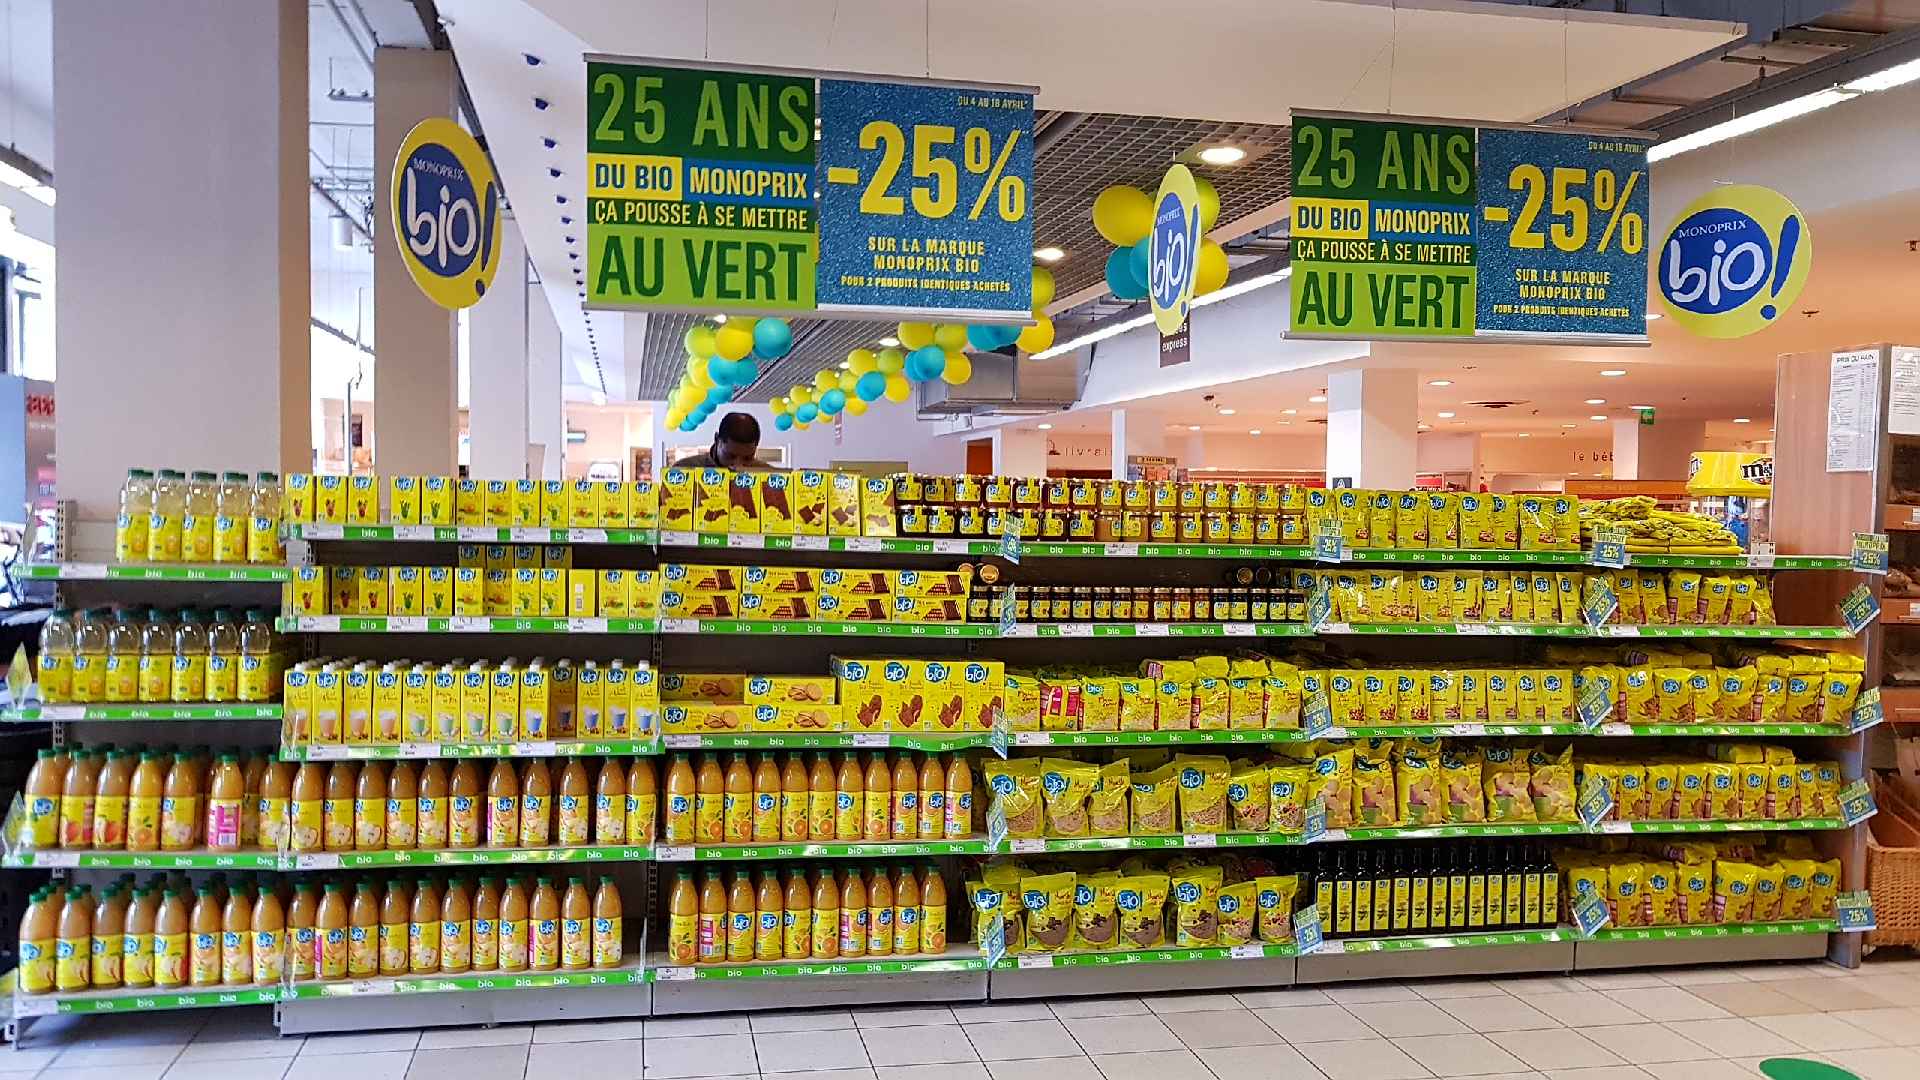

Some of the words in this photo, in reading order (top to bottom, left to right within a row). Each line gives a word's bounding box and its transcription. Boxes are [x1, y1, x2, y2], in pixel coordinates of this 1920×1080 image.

[970, 96, 976, 105] 4
[594, 73, 665, 144] 25
[693, 80, 809, 152] ANS
[1297, 126, 1356, 188] 25
[1377, 131, 1470, 194] ANS
[828, 120, 1025, 222] -25%
[596, 164, 625, 189] DU
[635, 166, 672, 191] BIO
[690, 166, 807, 199] MONOPRIX
[1484, 164, 1642, 254] -25%
[595, 200, 618, 224] ÇA
[625, 202, 691, 225] POUSSE
[698, 201, 708, 225] À
[715, 206, 734, 227] SE
[742, 207, 808, 230] METTRE
[1298, 206, 1322, 229] DU
[1330, 208, 1362, 231] BIO
[1376, 208, 1470, 235] MONOPRIX
[1678, 220, 1748, 238] MONOPRIX
[868, 236, 896, 252] SUR
[902, 238, 920, 252] LA
[926, 239, 984, 256] MARQUE
[1297, 240, 1316, 261] ÇA
[1322, 242, 1376, 260] POUSSE
[1380, 239, 1390, 260] À
[1395, 244, 1412, 261] SE
[1418, 244, 1471, 264] METTRE
[596, 236, 664, 297] AU
[683, 239, 807, 301] VERT
[874, 255, 948, 272] MONOPRIX
[956, 258, 980, 273] BIO
[1516, 268, 1538, 282] SUR
[1544, 270, 1556, 282] LA
[1562, 270, 1610, 286] MARQUE
[841, 276, 864, 286] POUR
[866, 278, 872, 286] 2
[875, 277, 918, 288] PRODUITS
[921, 278, 971, 291] IDENTIQUES
[1520, 285, 1581, 300] MONOPRIX
[1586, 288, 1606, 300] BIO
[1298, 272, 1352, 326] AU
[1368, 274, 1470, 328] VERT
[1162, 336, 1188, 352] express
[1065, 446, 1107, 456] livrai
[1592, 451, 1614, 462] béb
[362, 528, 378, 537] bio
[704, 537, 719, 545] bio
[776, 539, 791, 547] bio
[1861, 552, 1880, 566] -25%
[736, 624, 750, 632] bio
[772, 624, 786, 632] bio
[808, 624, 821, 632] bio
[843, 624, 856, 632] bio
[770, 738, 784, 746] bio
[1074, 734, 1087, 742] bio
[1106, 734, 1118, 742] bio
[596, 744, 610, 754] bio
[1134, 838, 1146, 846] bio
[950, 844, 963, 852] bio
[473, 854, 488, 862] bio
[624, 850, 639, 858] bio
[707, 850, 720, 858] bio
[1190, 951, 1202, 960] bio
[728, 968, 742, 977] bio
[478, 979, 494, 988] bio
[591, 975, 606, 984] bio
